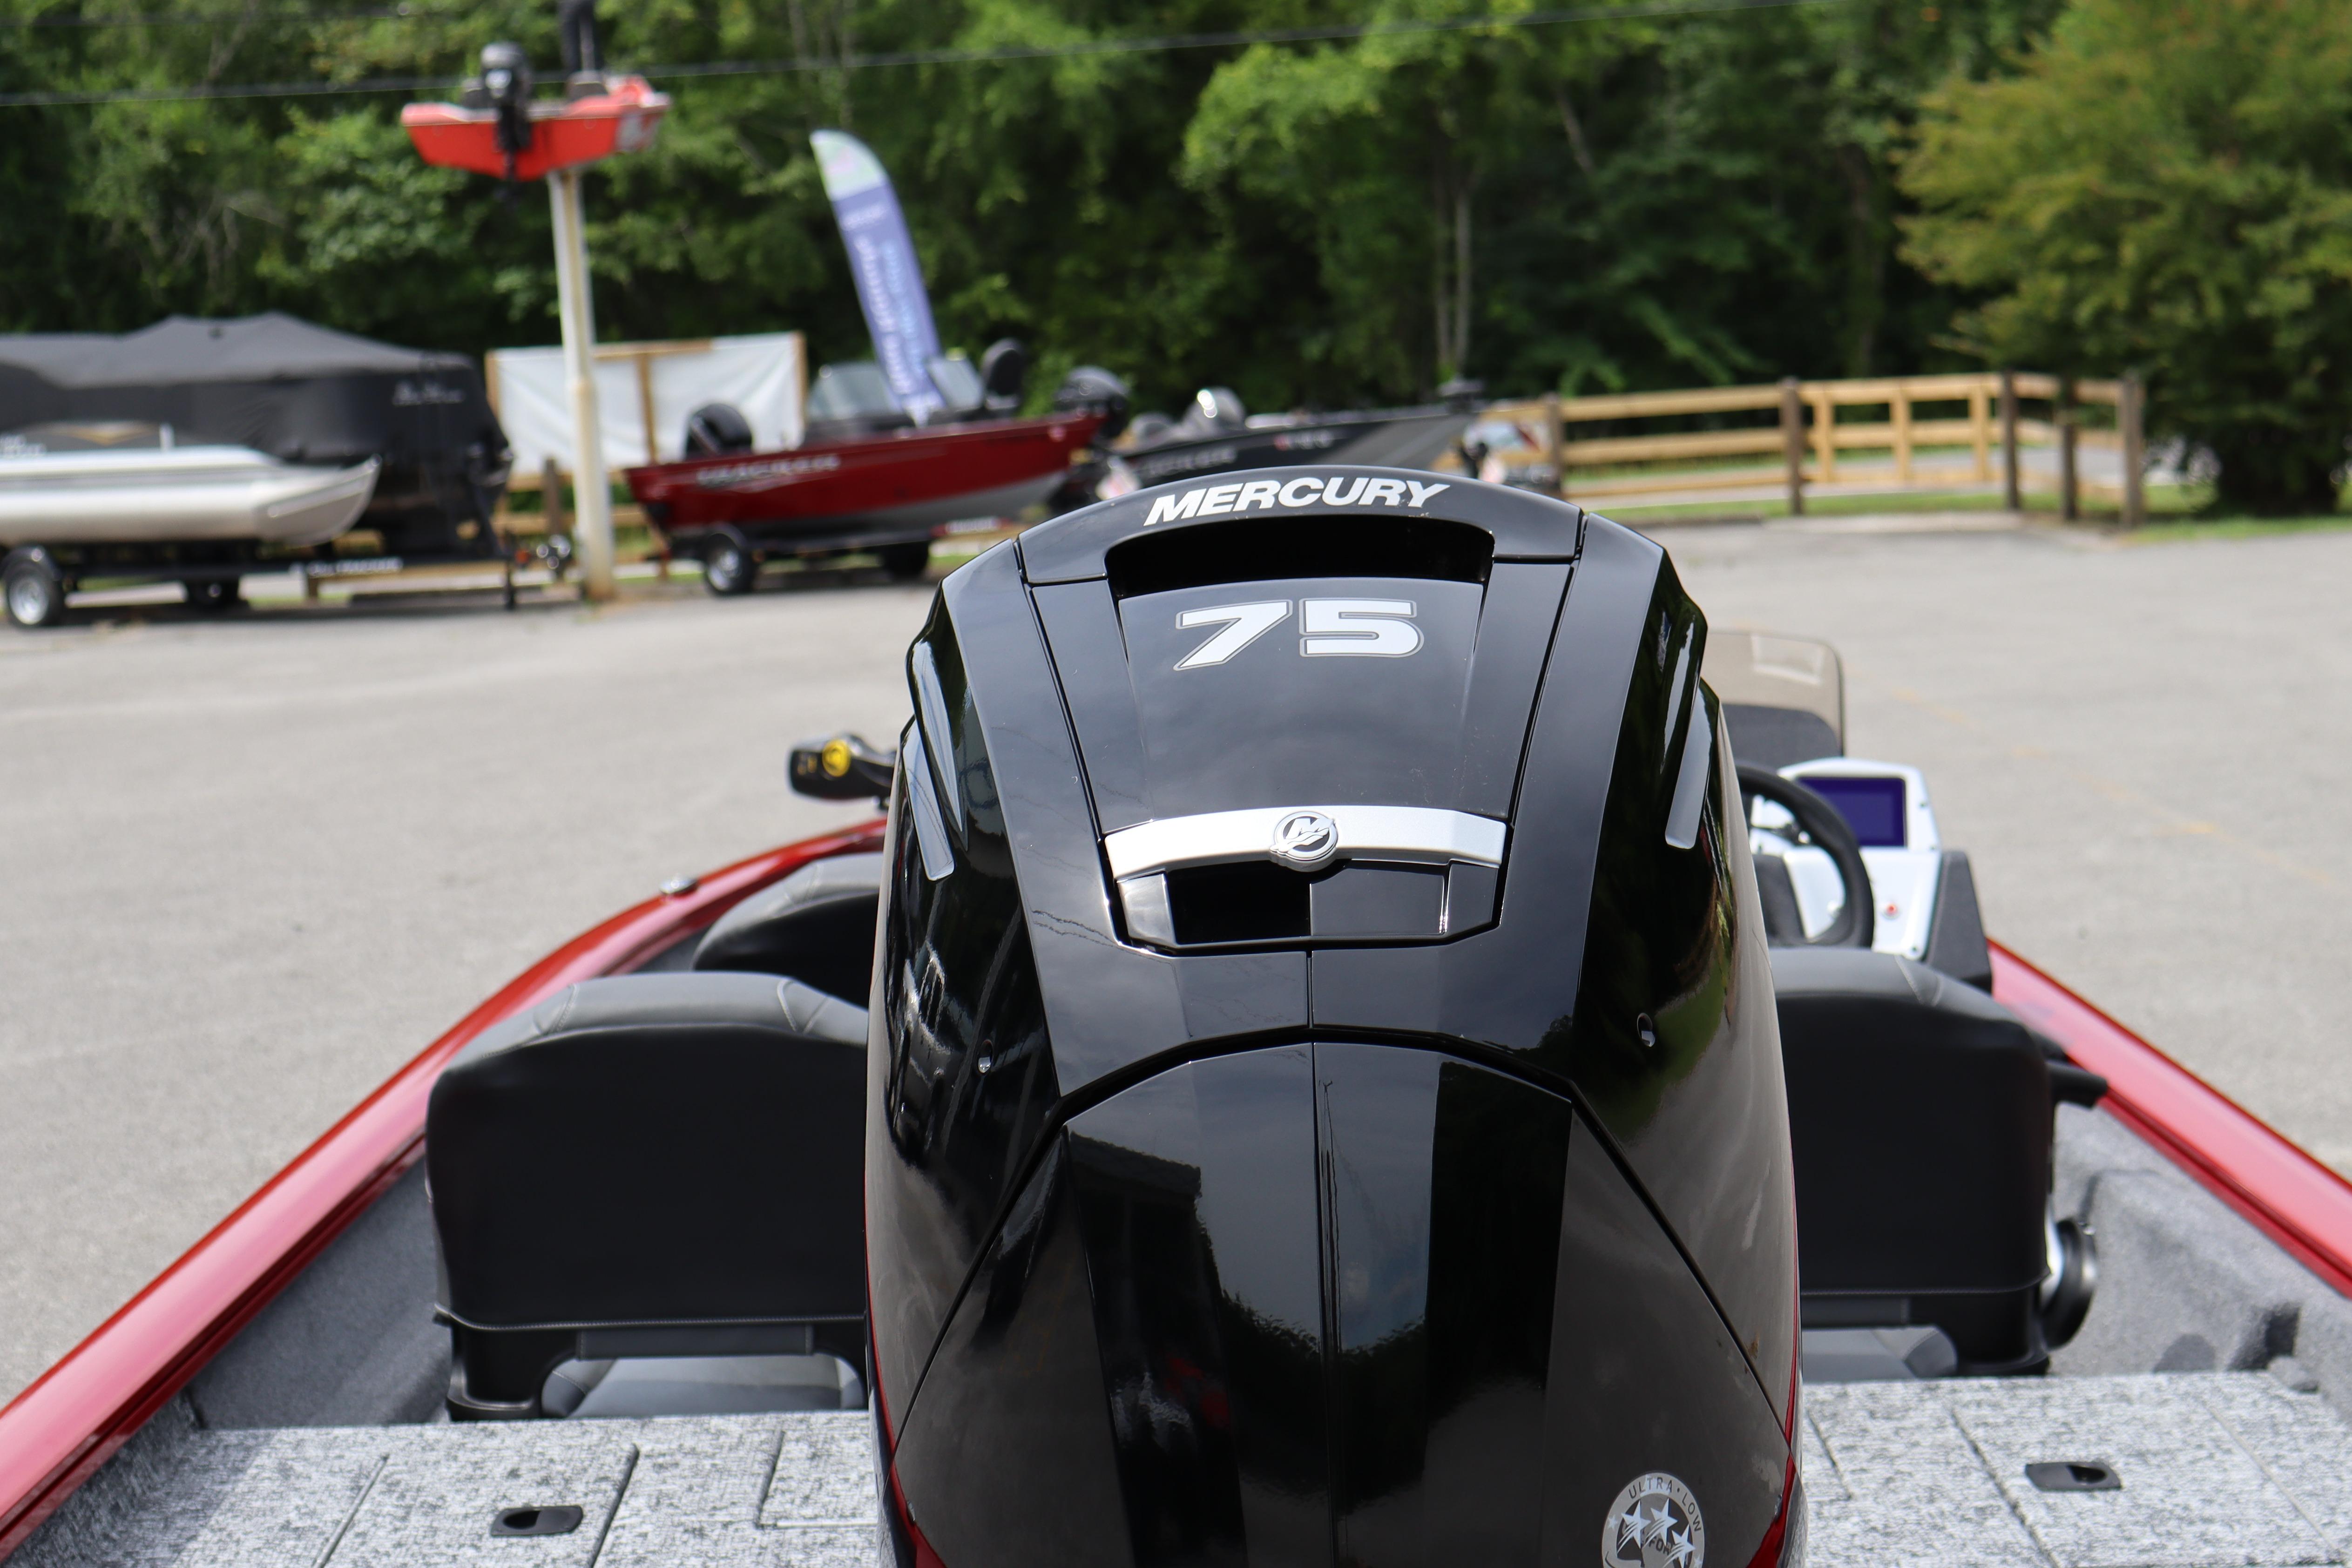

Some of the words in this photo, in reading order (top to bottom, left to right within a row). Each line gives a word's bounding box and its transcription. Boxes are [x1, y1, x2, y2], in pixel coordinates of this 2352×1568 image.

[1143, 477, 1451, 527] MERCURY
[1173, 598, 1425, 671] 75
[1629, 1477, 1673, 1499] ULTRA
[1682, 1493, 1702, 1532] LOW
